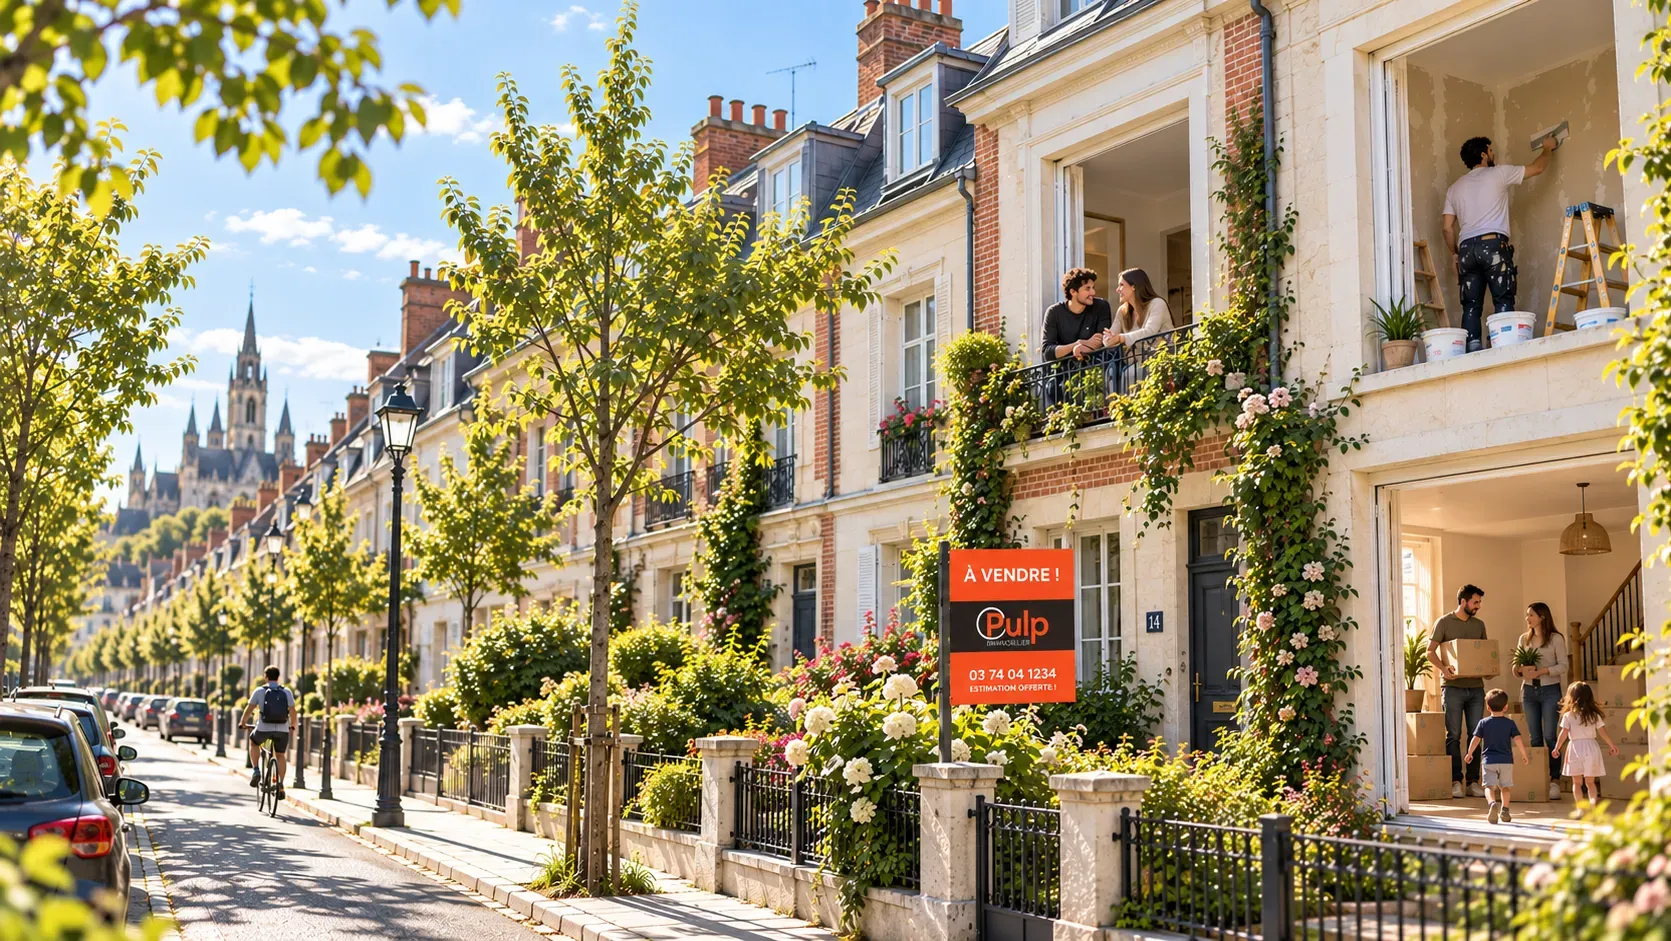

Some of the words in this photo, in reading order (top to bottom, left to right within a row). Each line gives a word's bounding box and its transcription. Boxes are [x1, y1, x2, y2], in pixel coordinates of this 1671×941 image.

[964, 565, 977, 582] À
[981, 567, 1050, 582] VENDRE
[1055, 568, 1059, 582] !
[986, 609, 1049, 645] Pulp
[1149, 615, 1161, 629] 14
[969, 669, 985, 681] 03
[989, 669, 1004, 681] 74
[1007, 668, 1024, 680] 04
[1028, 667, 1057, 680] 1234
[969, 685, 1017, 693] ESTIMATION
[1018, 684, 1053, 692] OFFERTE
